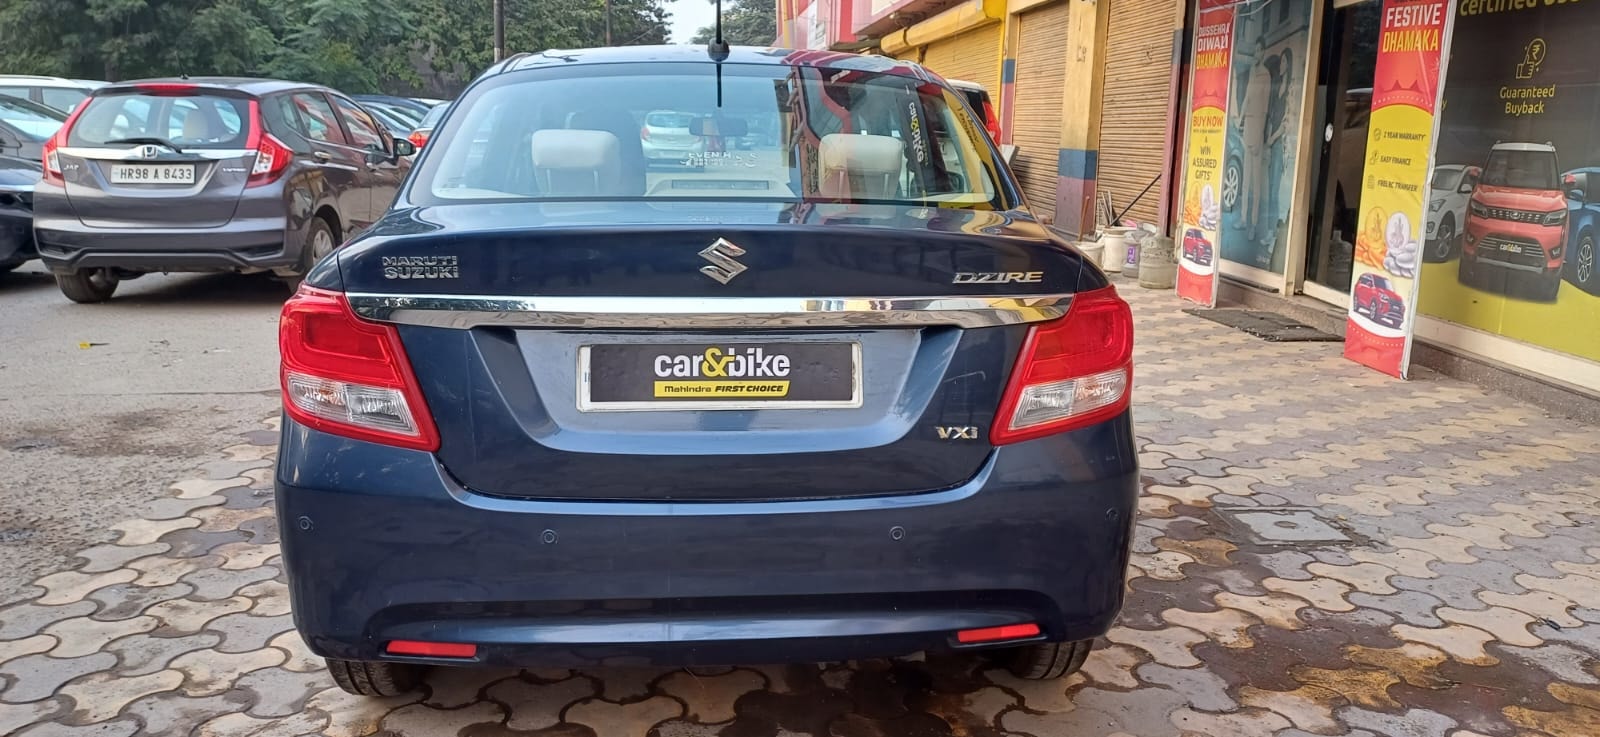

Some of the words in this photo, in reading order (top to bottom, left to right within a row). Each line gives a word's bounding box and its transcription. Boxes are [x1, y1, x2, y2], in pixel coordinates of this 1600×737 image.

[1385, 3, 1443, 28] FESTIVE
[1197, 34, 1229, 52] DIWALI
[1382, 28, 1440, 53] DHAMAKA
[1196, 50, 1229, 69] DHAMAKA
[1500, 84, 1556, 99] Guaranteed
[1505, 101, 1545, 117] Buyback
[1200, 146, 1211, 156] WIN
[1193, 157, 1217, 169] ASSURED
[119, 168, 150, 180] HR98
[153, 168, 160, 180] A
[164, 168, 193, 180] 8433
[381, 255, 458, 267] MARUTI
[384, 266, 460, 280] SUZUKI
[952, 271, 1044, 284] DZIRE
[654, 346, 791, 378] car&bike
[664, 385, 712, 393] Mahindra
[714, 385, 746, 393] FIRST
[745, 384, 784, 393] CHOICE
